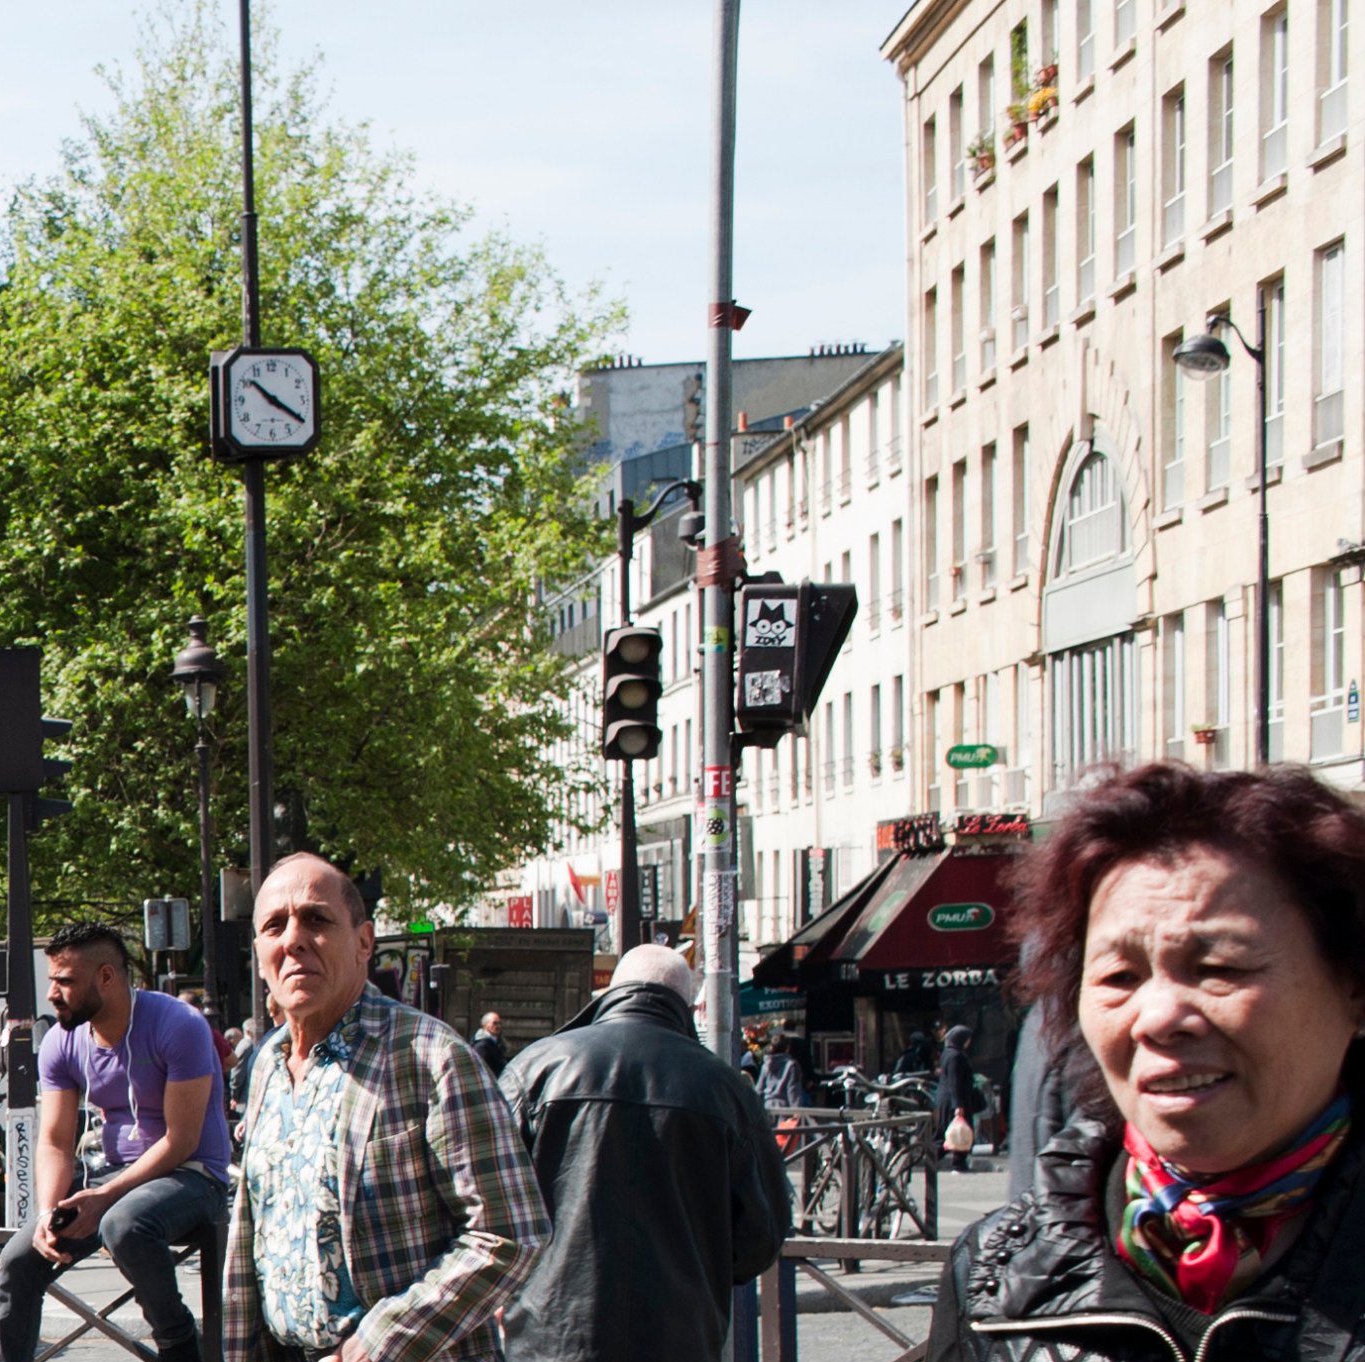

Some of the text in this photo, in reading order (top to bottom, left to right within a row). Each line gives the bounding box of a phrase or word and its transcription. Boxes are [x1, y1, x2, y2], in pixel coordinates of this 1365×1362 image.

[252, 367, 261, 377] 11
[266, 362, 277, 372] 12
[284, 367, 289, 377] 1
[294, 379, 301, 389] 2
[238, 395, 245, 406] 9
[243, 412, 250, 422] 8
[255, 423, 262, 434] 7
[950, 751, 976, 764] PMU
[960, 814, 1029, 834] Le Zorba
[936, 911, 966, 924] PMU
[884, 968, 999, 990] LE ZORBA
